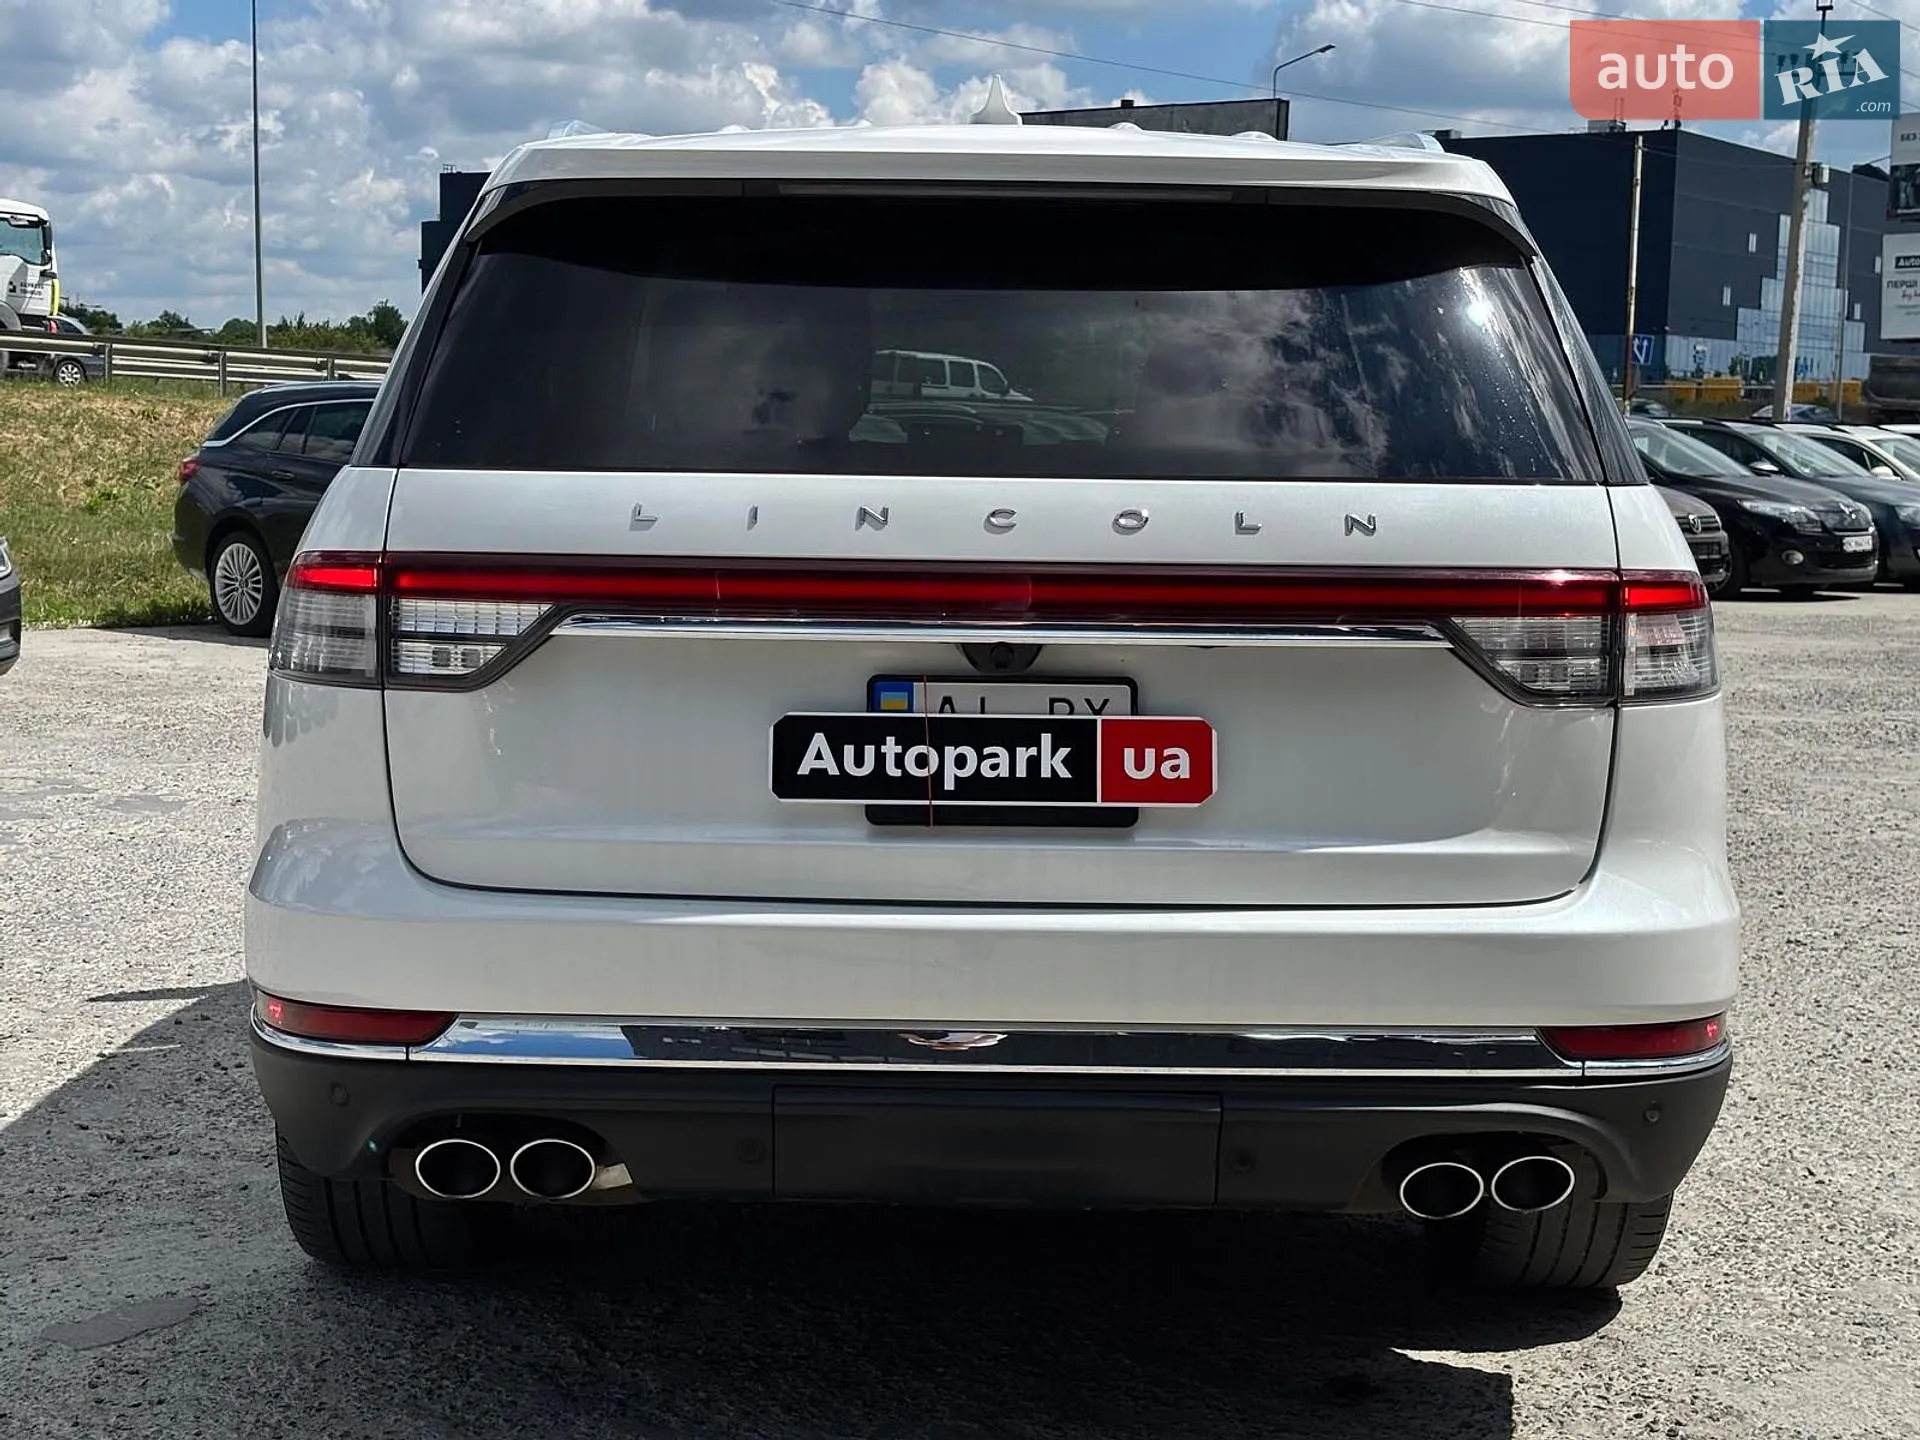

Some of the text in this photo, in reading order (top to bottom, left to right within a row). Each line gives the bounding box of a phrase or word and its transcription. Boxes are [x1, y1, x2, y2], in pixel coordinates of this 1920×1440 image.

[631, 502, 1377, 537] LINCOLN
[796, 732, 1191, 791] Autopark ua
